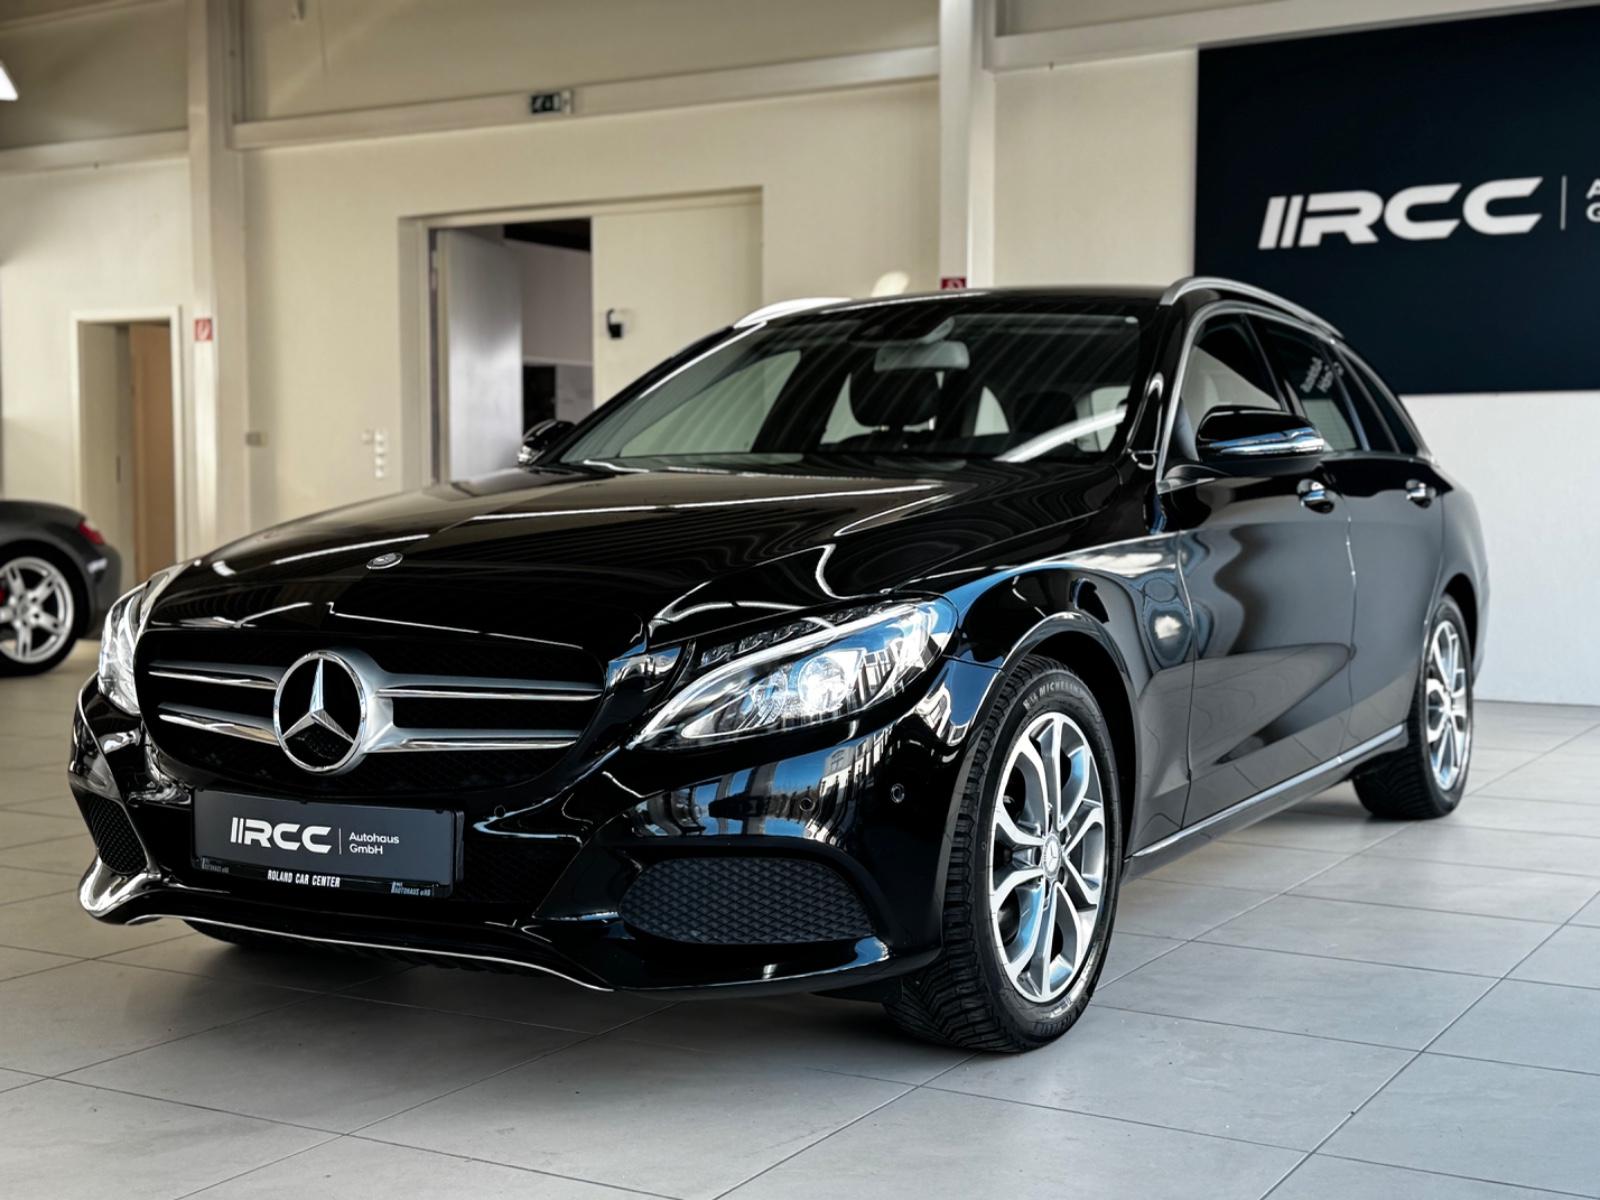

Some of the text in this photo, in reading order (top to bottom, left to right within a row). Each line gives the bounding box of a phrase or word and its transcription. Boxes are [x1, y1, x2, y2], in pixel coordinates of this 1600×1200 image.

[1039, 681, 1083, 697] MICHELIN
[349, 831, 400, 845] Autohaus
[349, 844, 384, 855] GmbH
[267, 869, 341, 888] ROLAND CAR CENTER
